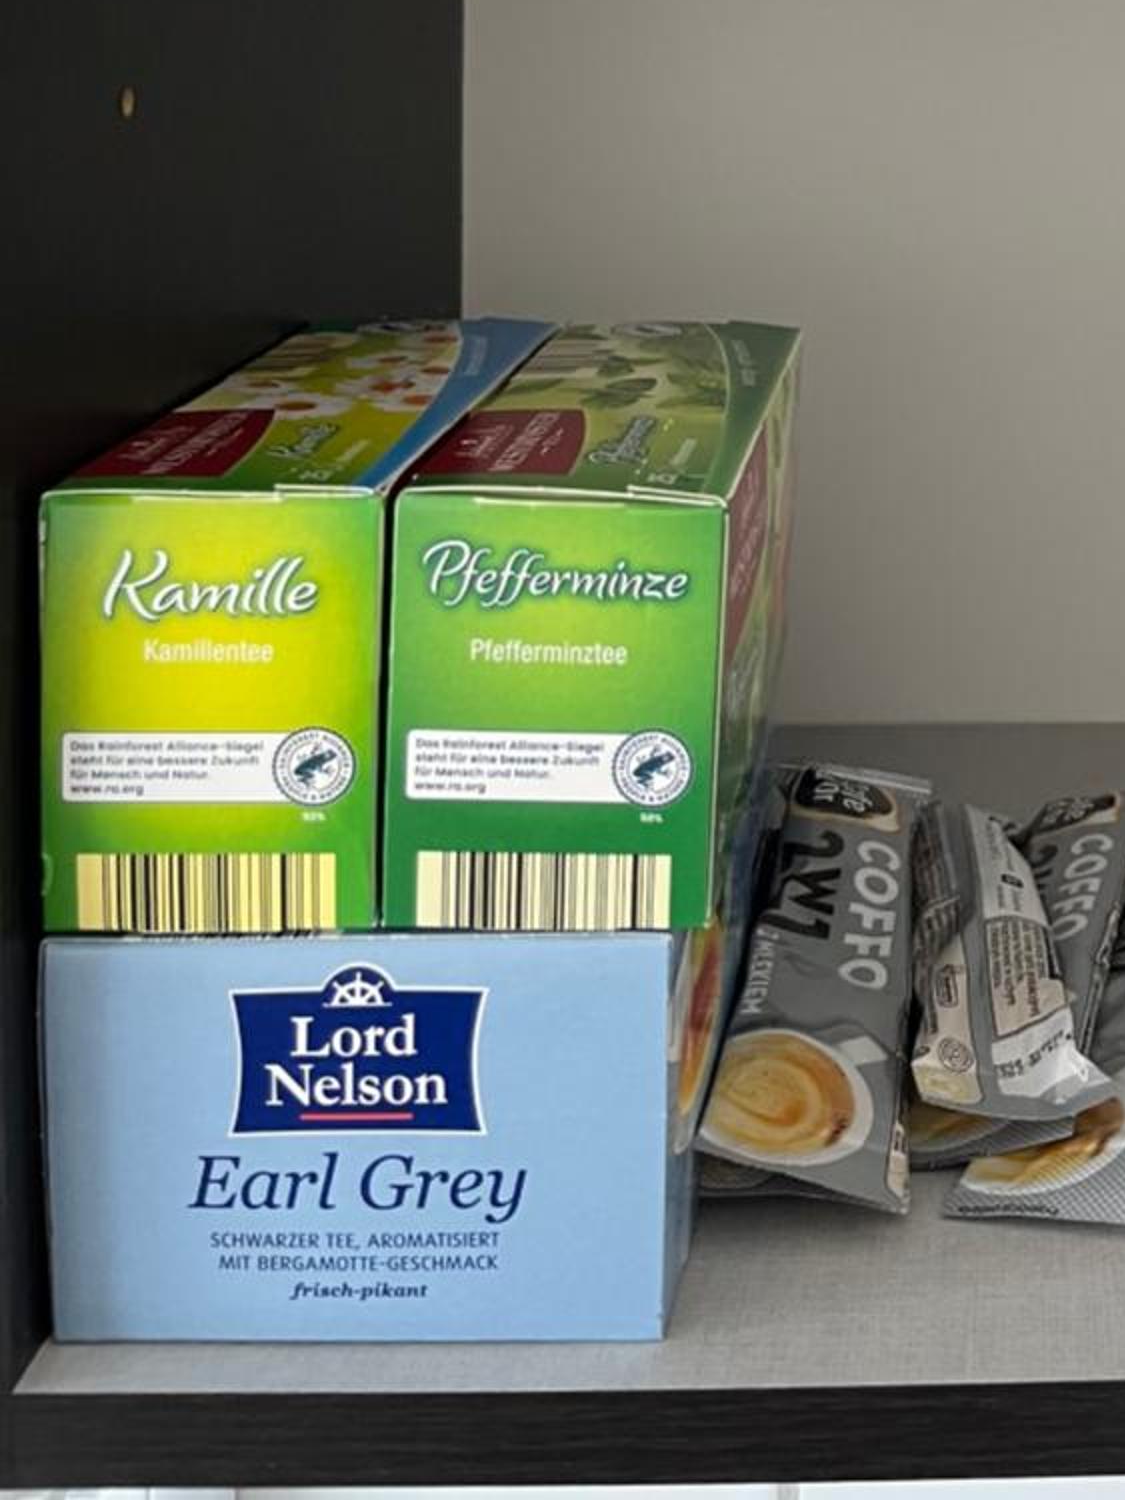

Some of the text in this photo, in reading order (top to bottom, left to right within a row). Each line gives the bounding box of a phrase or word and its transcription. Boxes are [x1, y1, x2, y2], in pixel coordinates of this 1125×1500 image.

[102, 549, 320, 622] Kamille
[422, 539, 690, 611] Pfefferminze
[143, 638, 275, 663] Kamillentee
[469, 637, 629, 666] Pfefferminztee
[69, 740, 96, 751] Das
[98, 739, 164, 751] Rainforest
[414, 738, 440, 749] Das
[442, 738, 507, 750] Rainforest
[290, 1013, 418, 1058] Lord
[264, 1062, 449, 1107] Nelson
[188, 1151, 528, 1224] Earl Grey
[209, 1230, 500, 1252] SCHWARZER TEE, AROMATISIERT
[218, 1254, 499, 1272] MIT BERGAMOTTE-GESCHMACK
[290, 1280, 428, 1301] frisch-pikant
